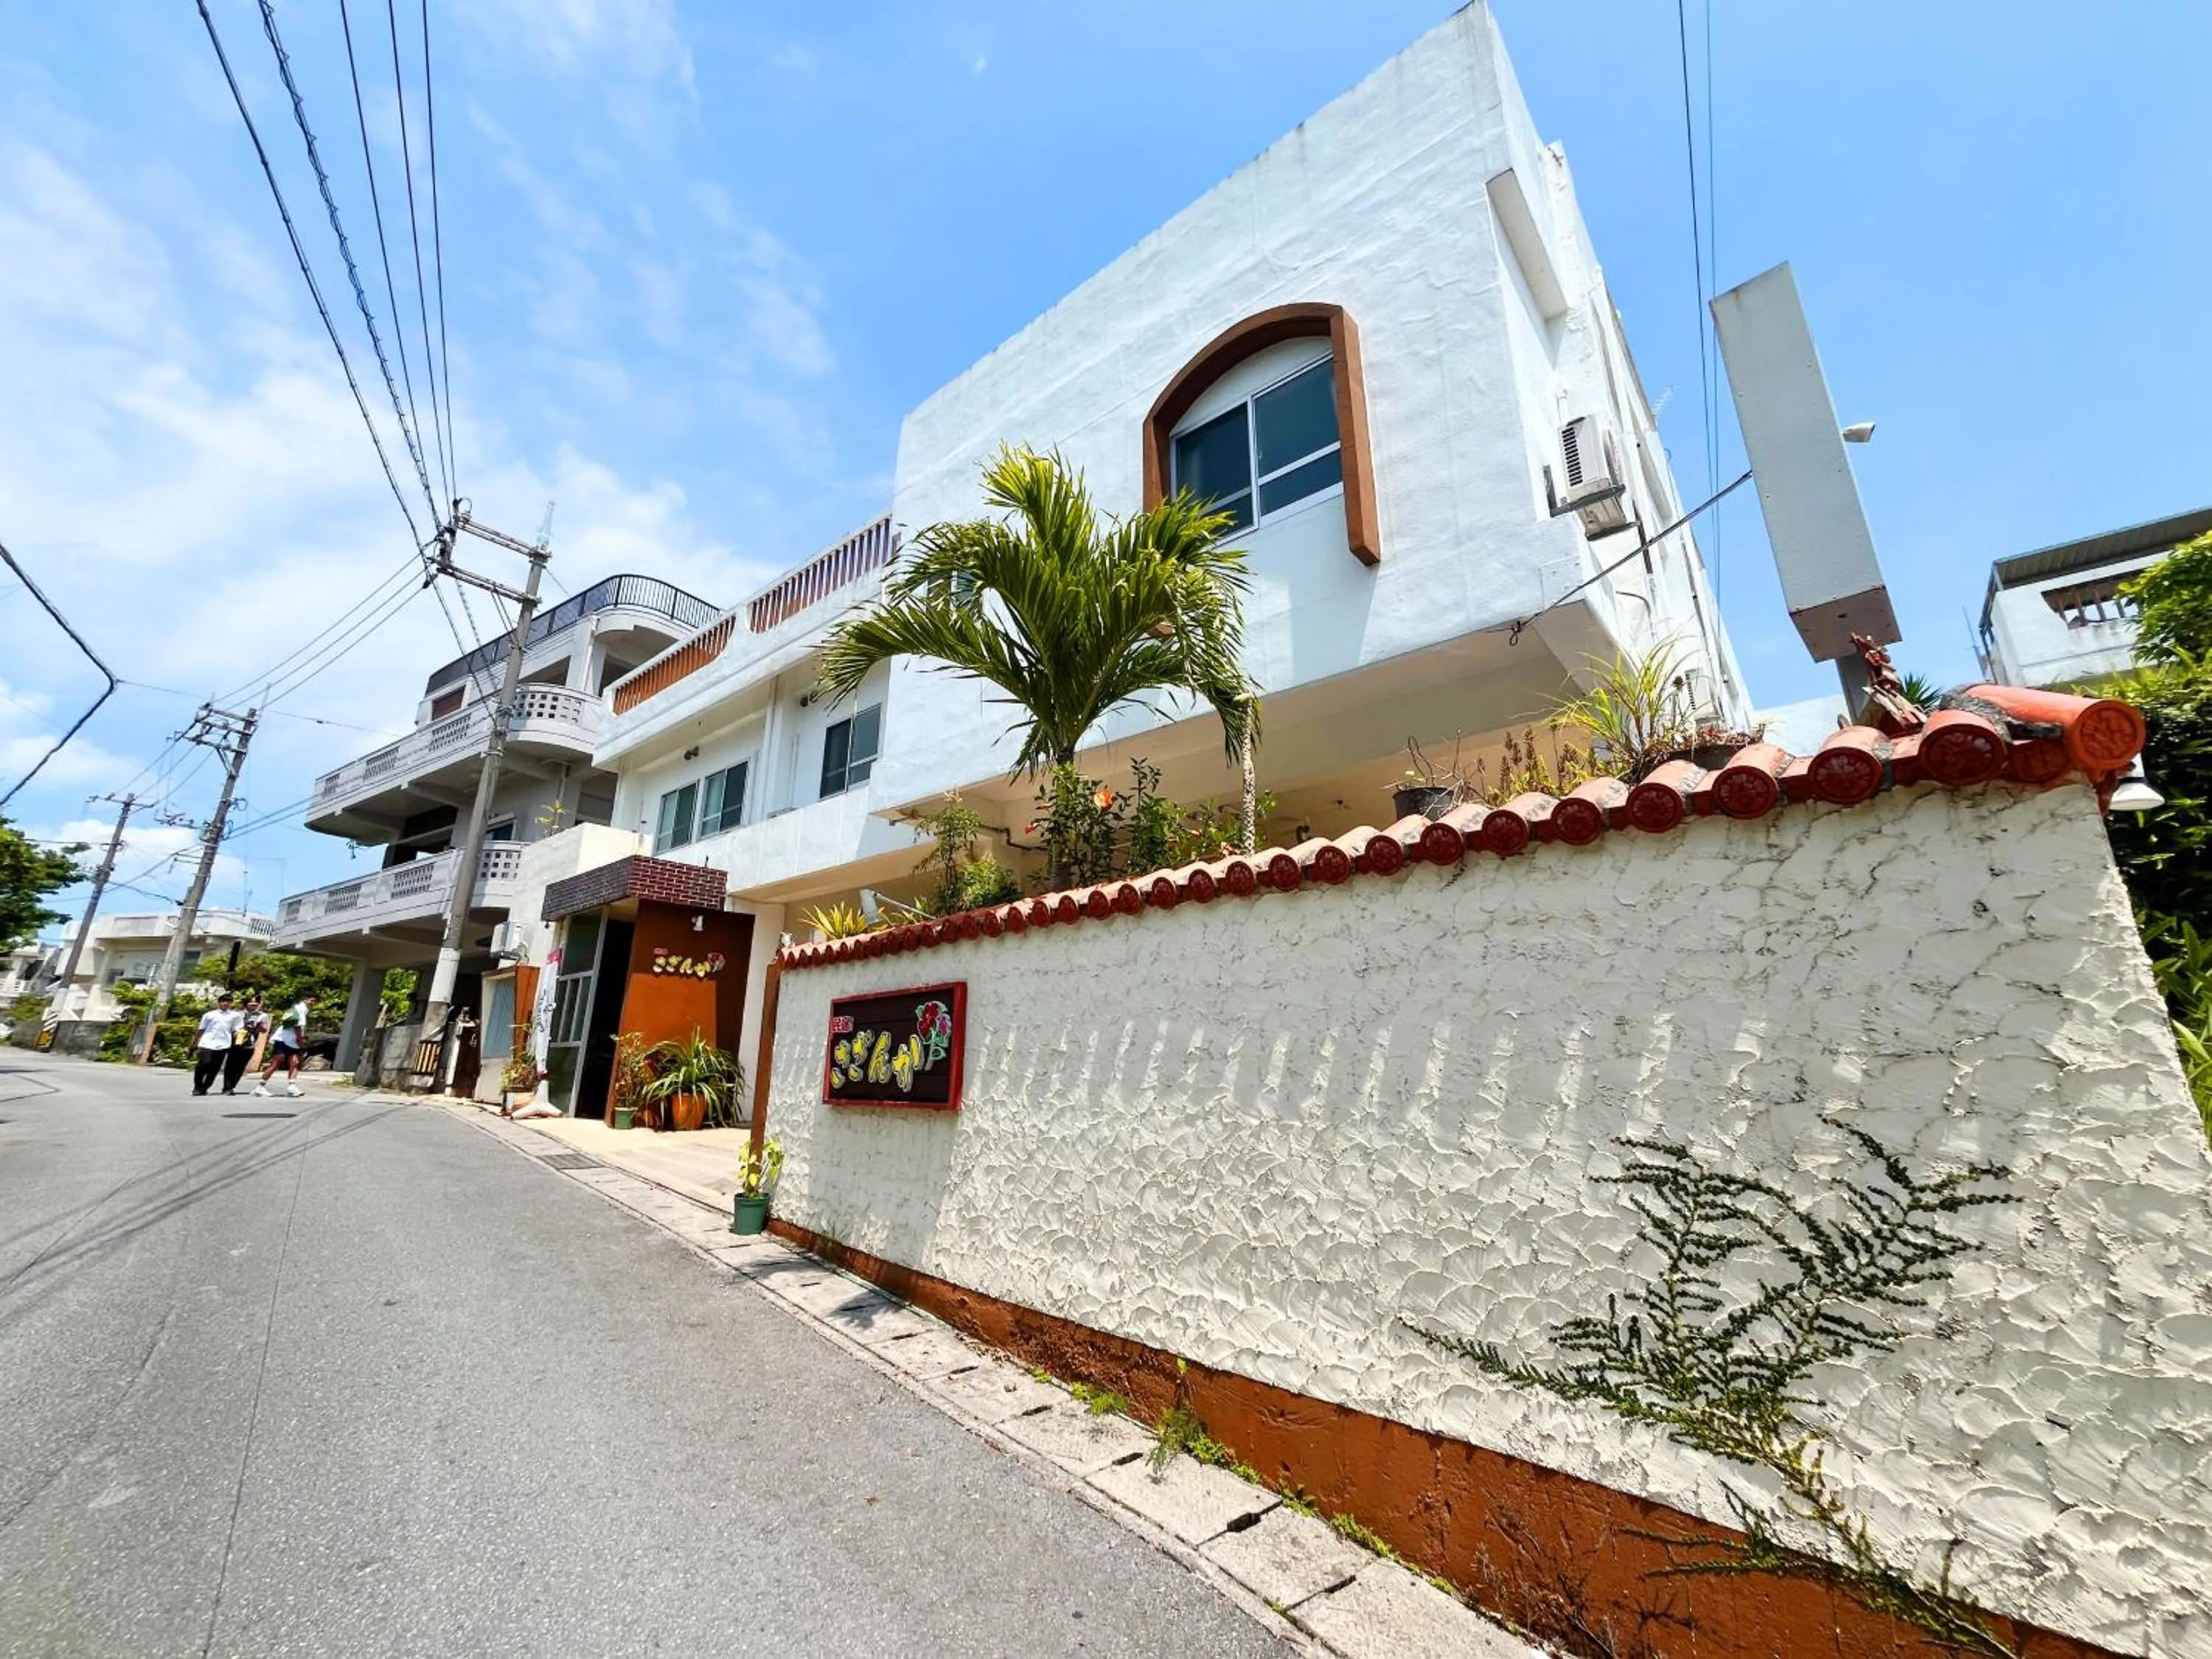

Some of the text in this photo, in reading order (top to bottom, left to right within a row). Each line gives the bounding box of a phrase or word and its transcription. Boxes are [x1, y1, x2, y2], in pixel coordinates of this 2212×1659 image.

[653, 956, 711, 977] さざんか
[831, 1030, 922, 1092] さざんか
